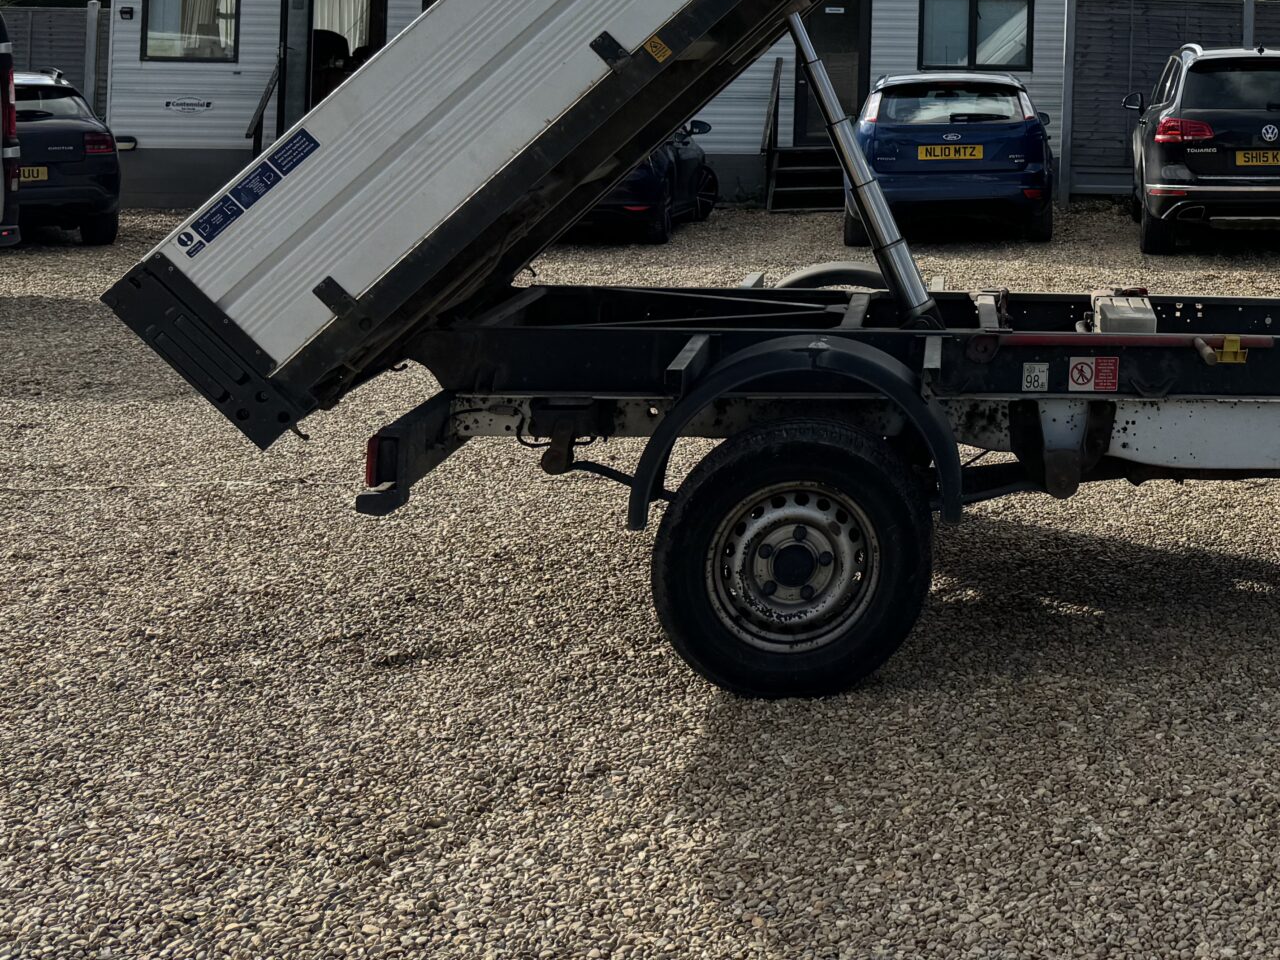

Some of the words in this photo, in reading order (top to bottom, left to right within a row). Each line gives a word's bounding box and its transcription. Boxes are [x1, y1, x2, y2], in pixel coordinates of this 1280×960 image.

[925, 147, 950, 158] NL10
[953, 147, 977, 157] MTZ
[1243, 152, 1269, 163] SH15
